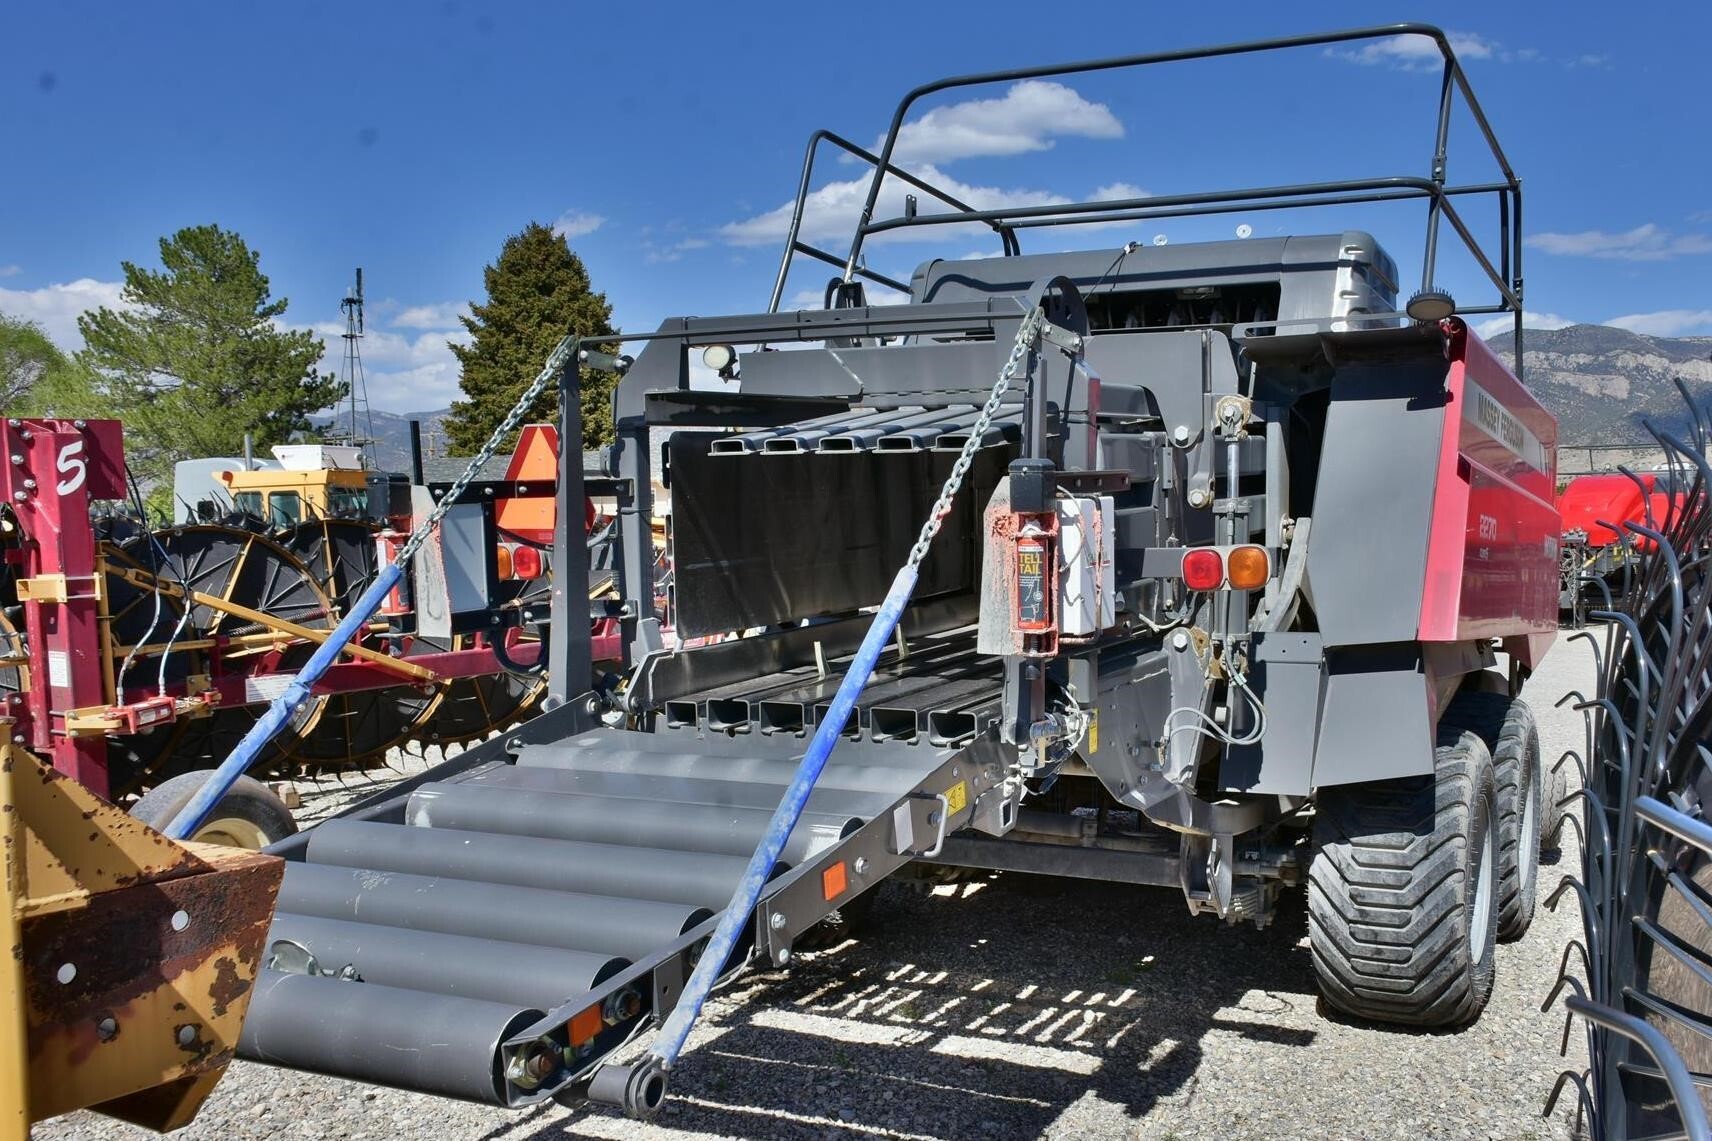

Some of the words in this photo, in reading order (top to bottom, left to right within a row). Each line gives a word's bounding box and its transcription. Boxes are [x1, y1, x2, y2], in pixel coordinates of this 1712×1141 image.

[1478, 392, 1501, 436] MASSEY
[56, 441, 87, 496] 5
[1018, 553, 1042, 564] TELL
[1018, 564, 1042, 575] TAIL
